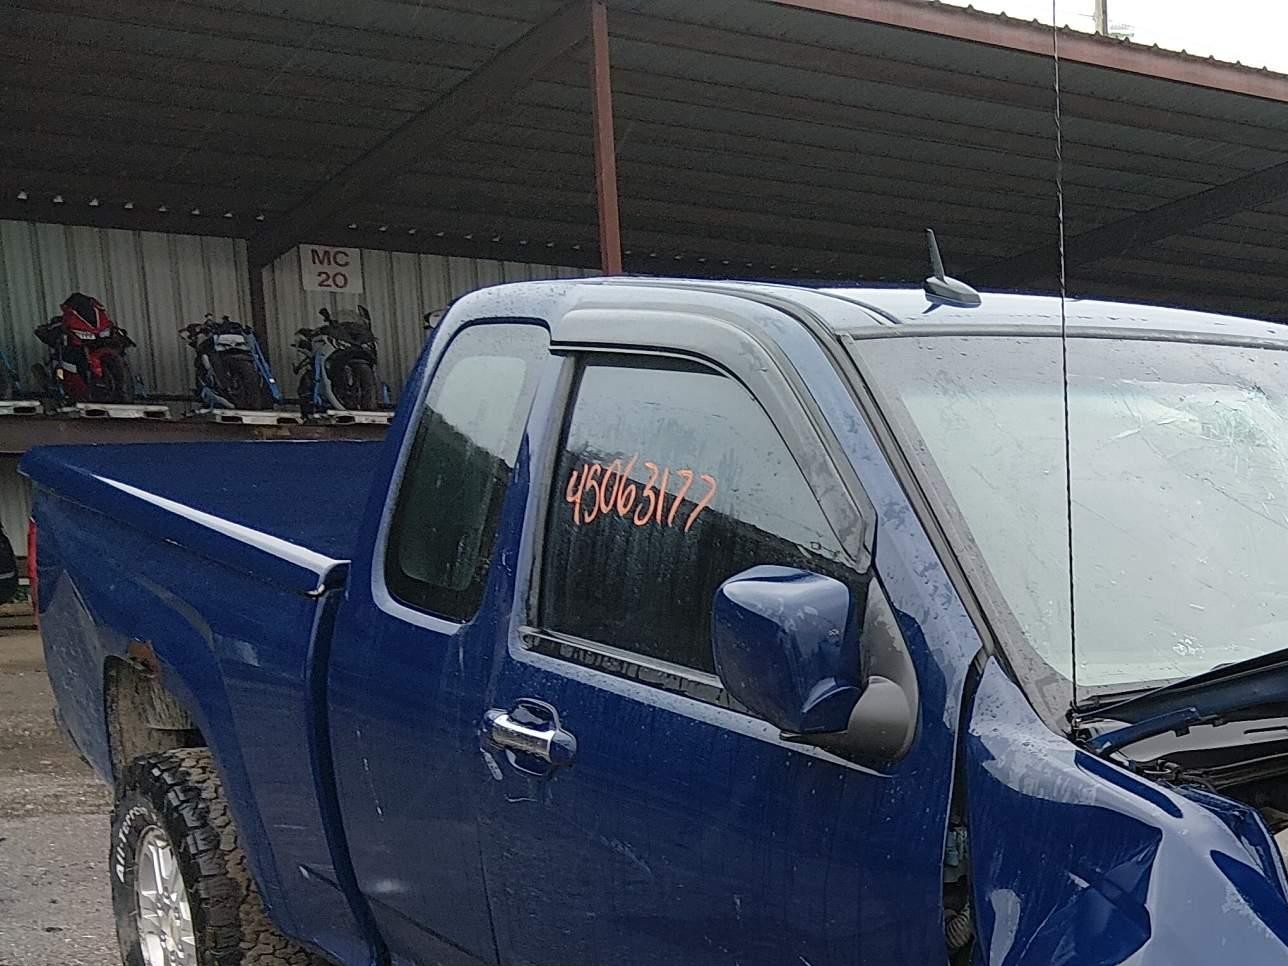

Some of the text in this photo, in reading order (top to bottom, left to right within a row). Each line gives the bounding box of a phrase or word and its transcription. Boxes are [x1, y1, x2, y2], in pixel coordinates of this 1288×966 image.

[311, 249, 350, 267] MC
[317, 271, 348, 288] 20
[566, 452, 717, 533] 45063177
